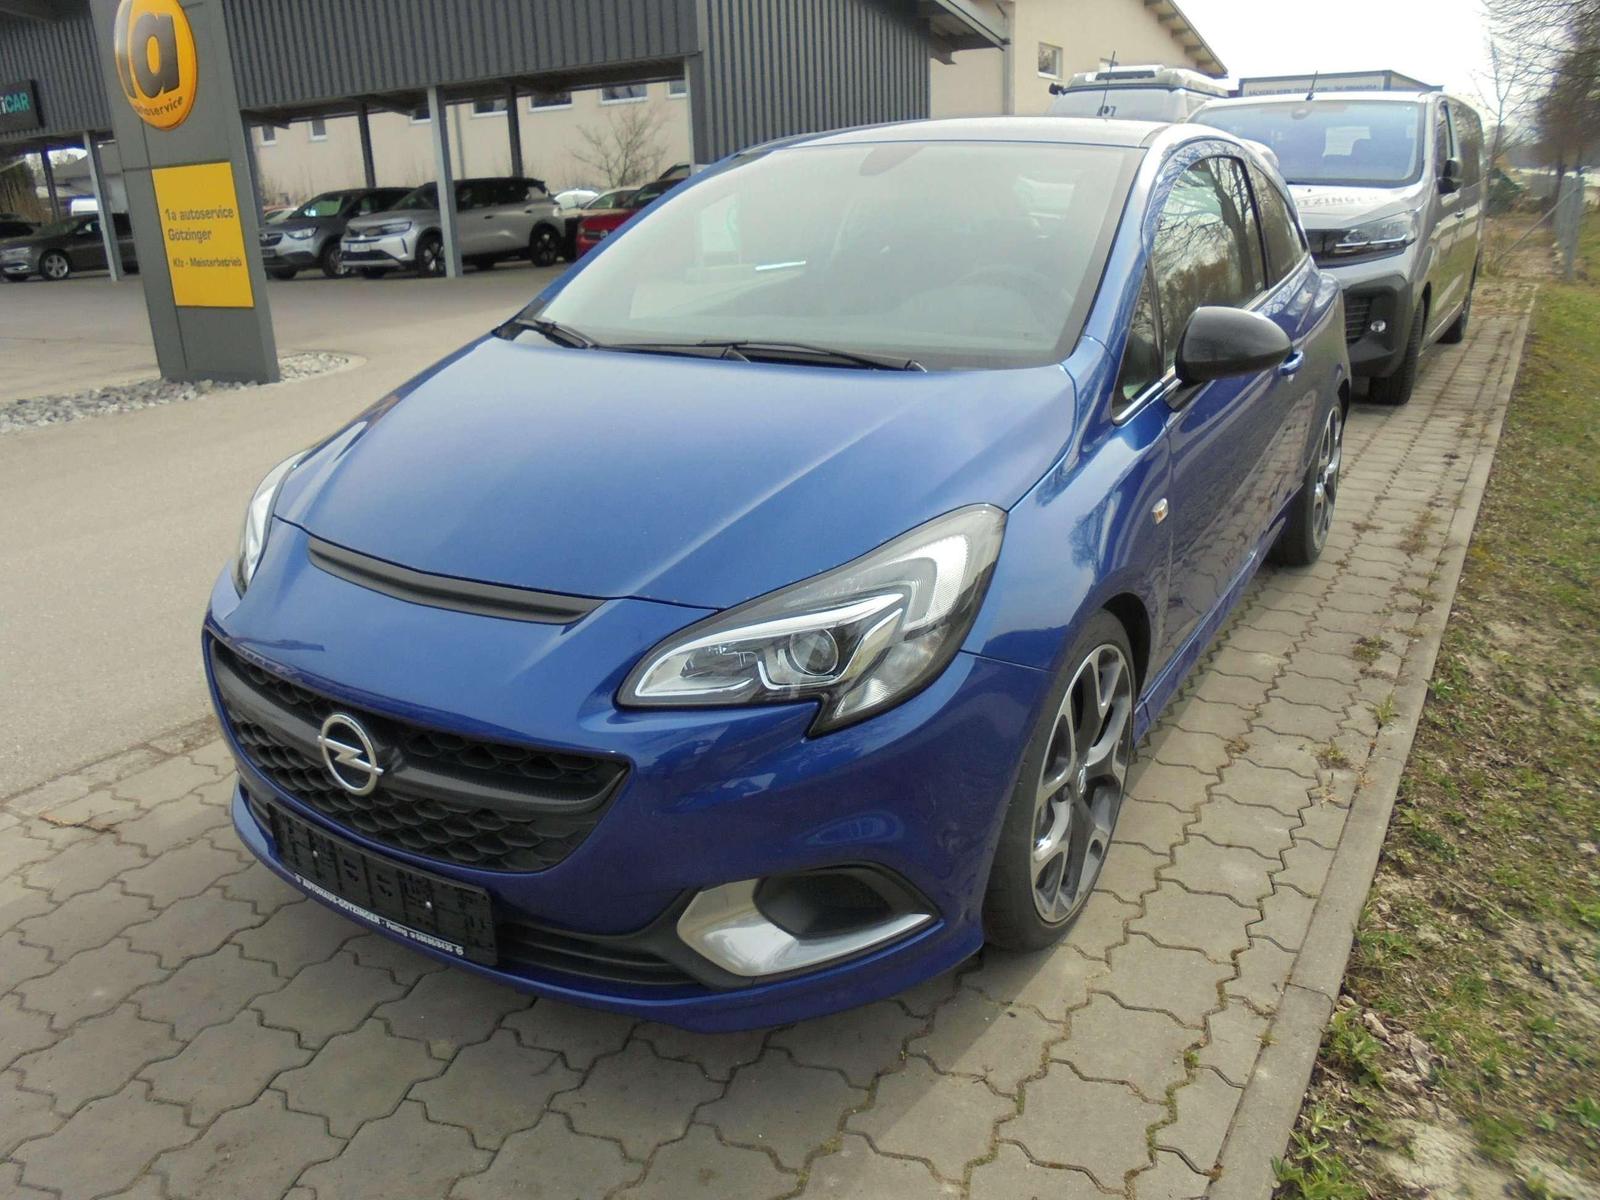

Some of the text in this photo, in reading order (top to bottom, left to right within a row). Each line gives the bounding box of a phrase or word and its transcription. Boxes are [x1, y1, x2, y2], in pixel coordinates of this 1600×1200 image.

[0, 92, 30, 114] iCAR
[180, 205, 235, 221] autoservice
[190, 257, 242, 267] Meisterbetrieb
